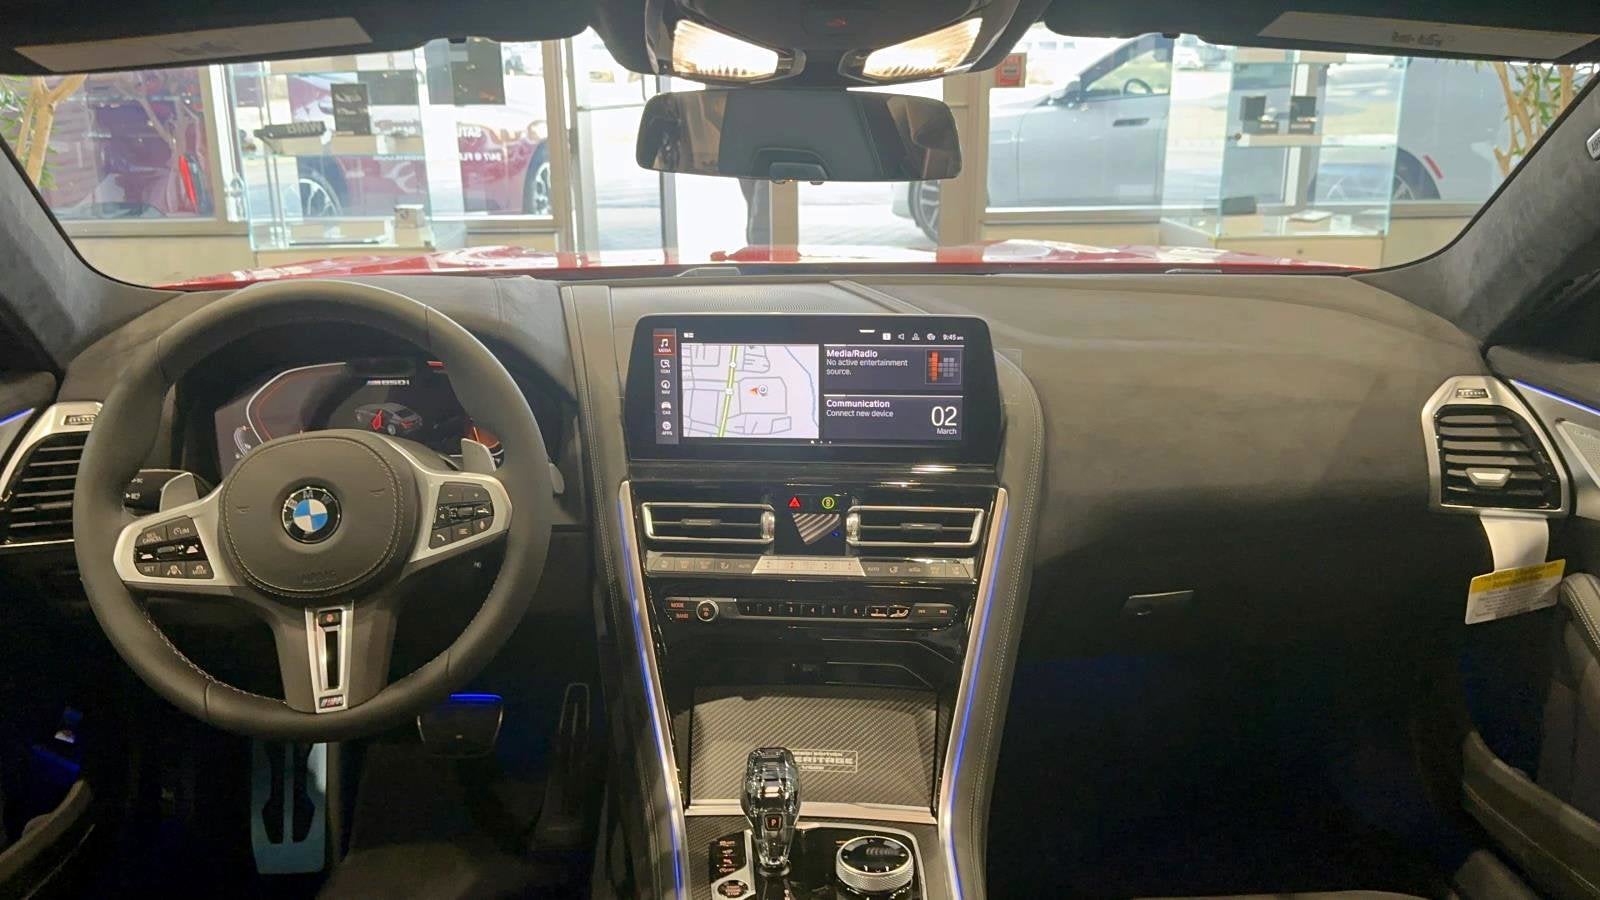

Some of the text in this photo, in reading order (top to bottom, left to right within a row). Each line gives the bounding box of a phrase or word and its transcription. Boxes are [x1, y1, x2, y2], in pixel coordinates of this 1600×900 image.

[826, 349, 878, 358] Media/Radio
[826, 400, 890, 408] Communication
[871, 410, 894, 418] device
[931, 406, 957, 427] 02
[794, 756, 854, 765] ERITAGE
